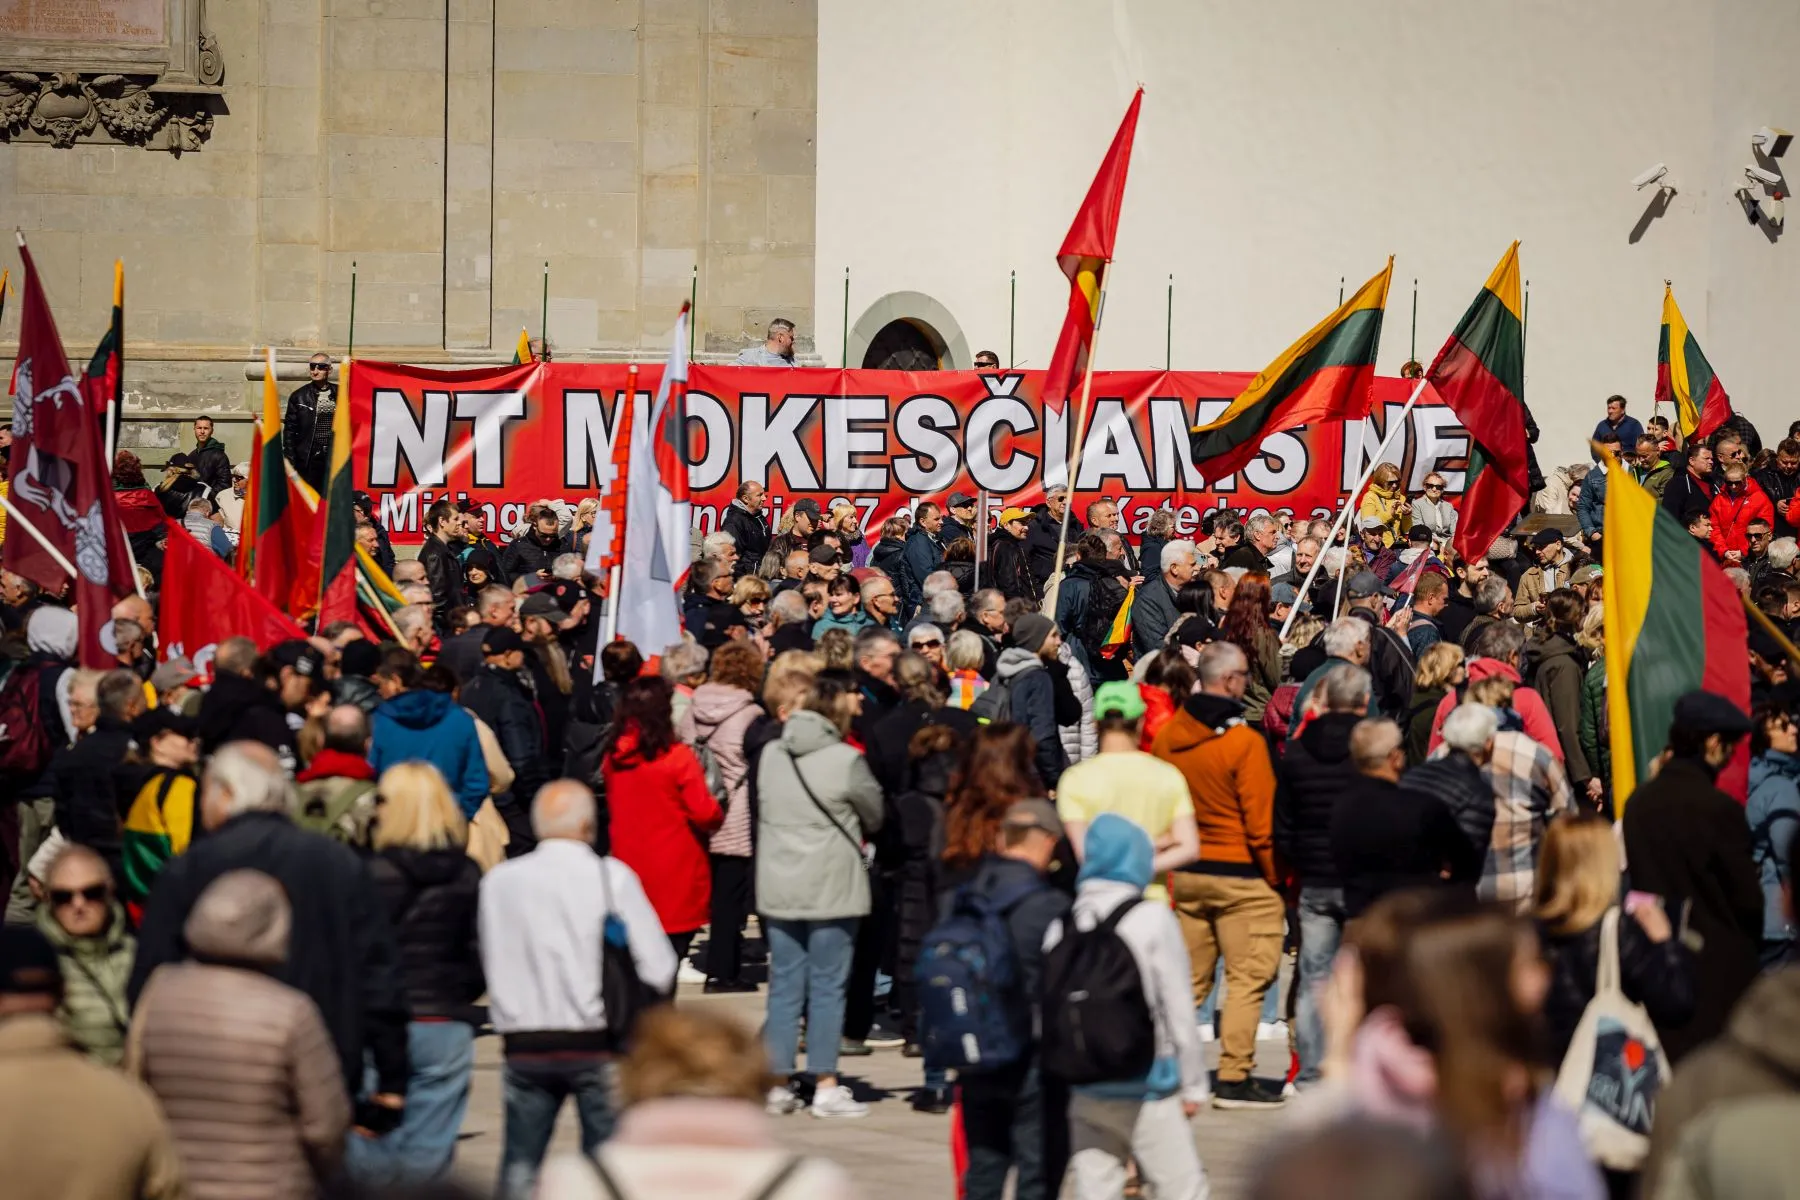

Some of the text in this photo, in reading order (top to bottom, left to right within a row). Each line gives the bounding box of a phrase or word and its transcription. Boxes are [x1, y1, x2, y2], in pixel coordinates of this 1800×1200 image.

[368, 373, 1471, 495] NT MOKESČIAMS NE
